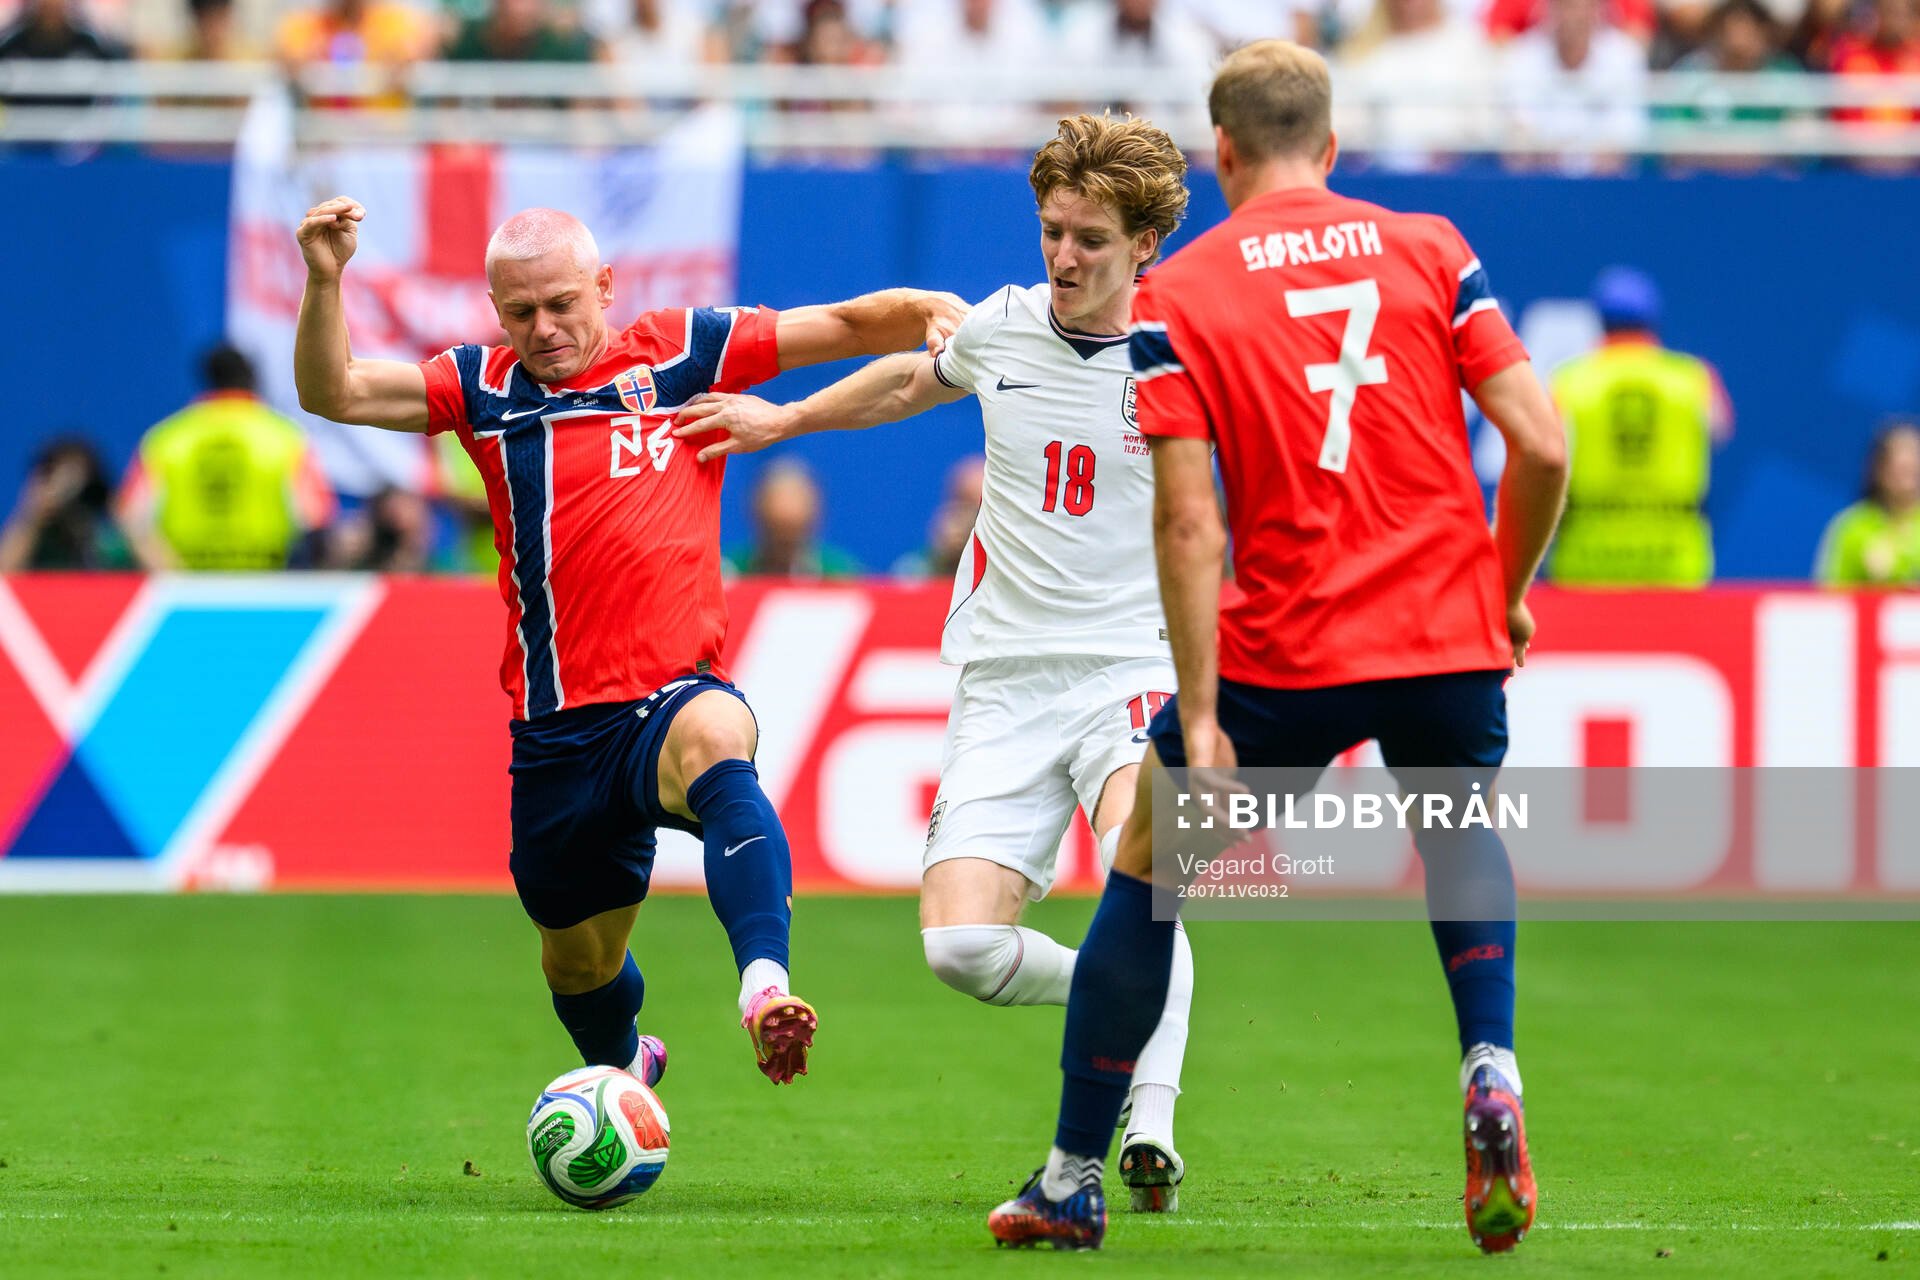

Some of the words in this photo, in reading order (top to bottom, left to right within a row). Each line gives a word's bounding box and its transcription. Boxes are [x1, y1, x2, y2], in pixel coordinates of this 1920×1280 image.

[1239, 221, 1383, 272] SØRLOTH
[1284, 278, 1389, 474] 7
[609, 415, 675, 478] 26
[1042, 440, 1096, 517] 18
